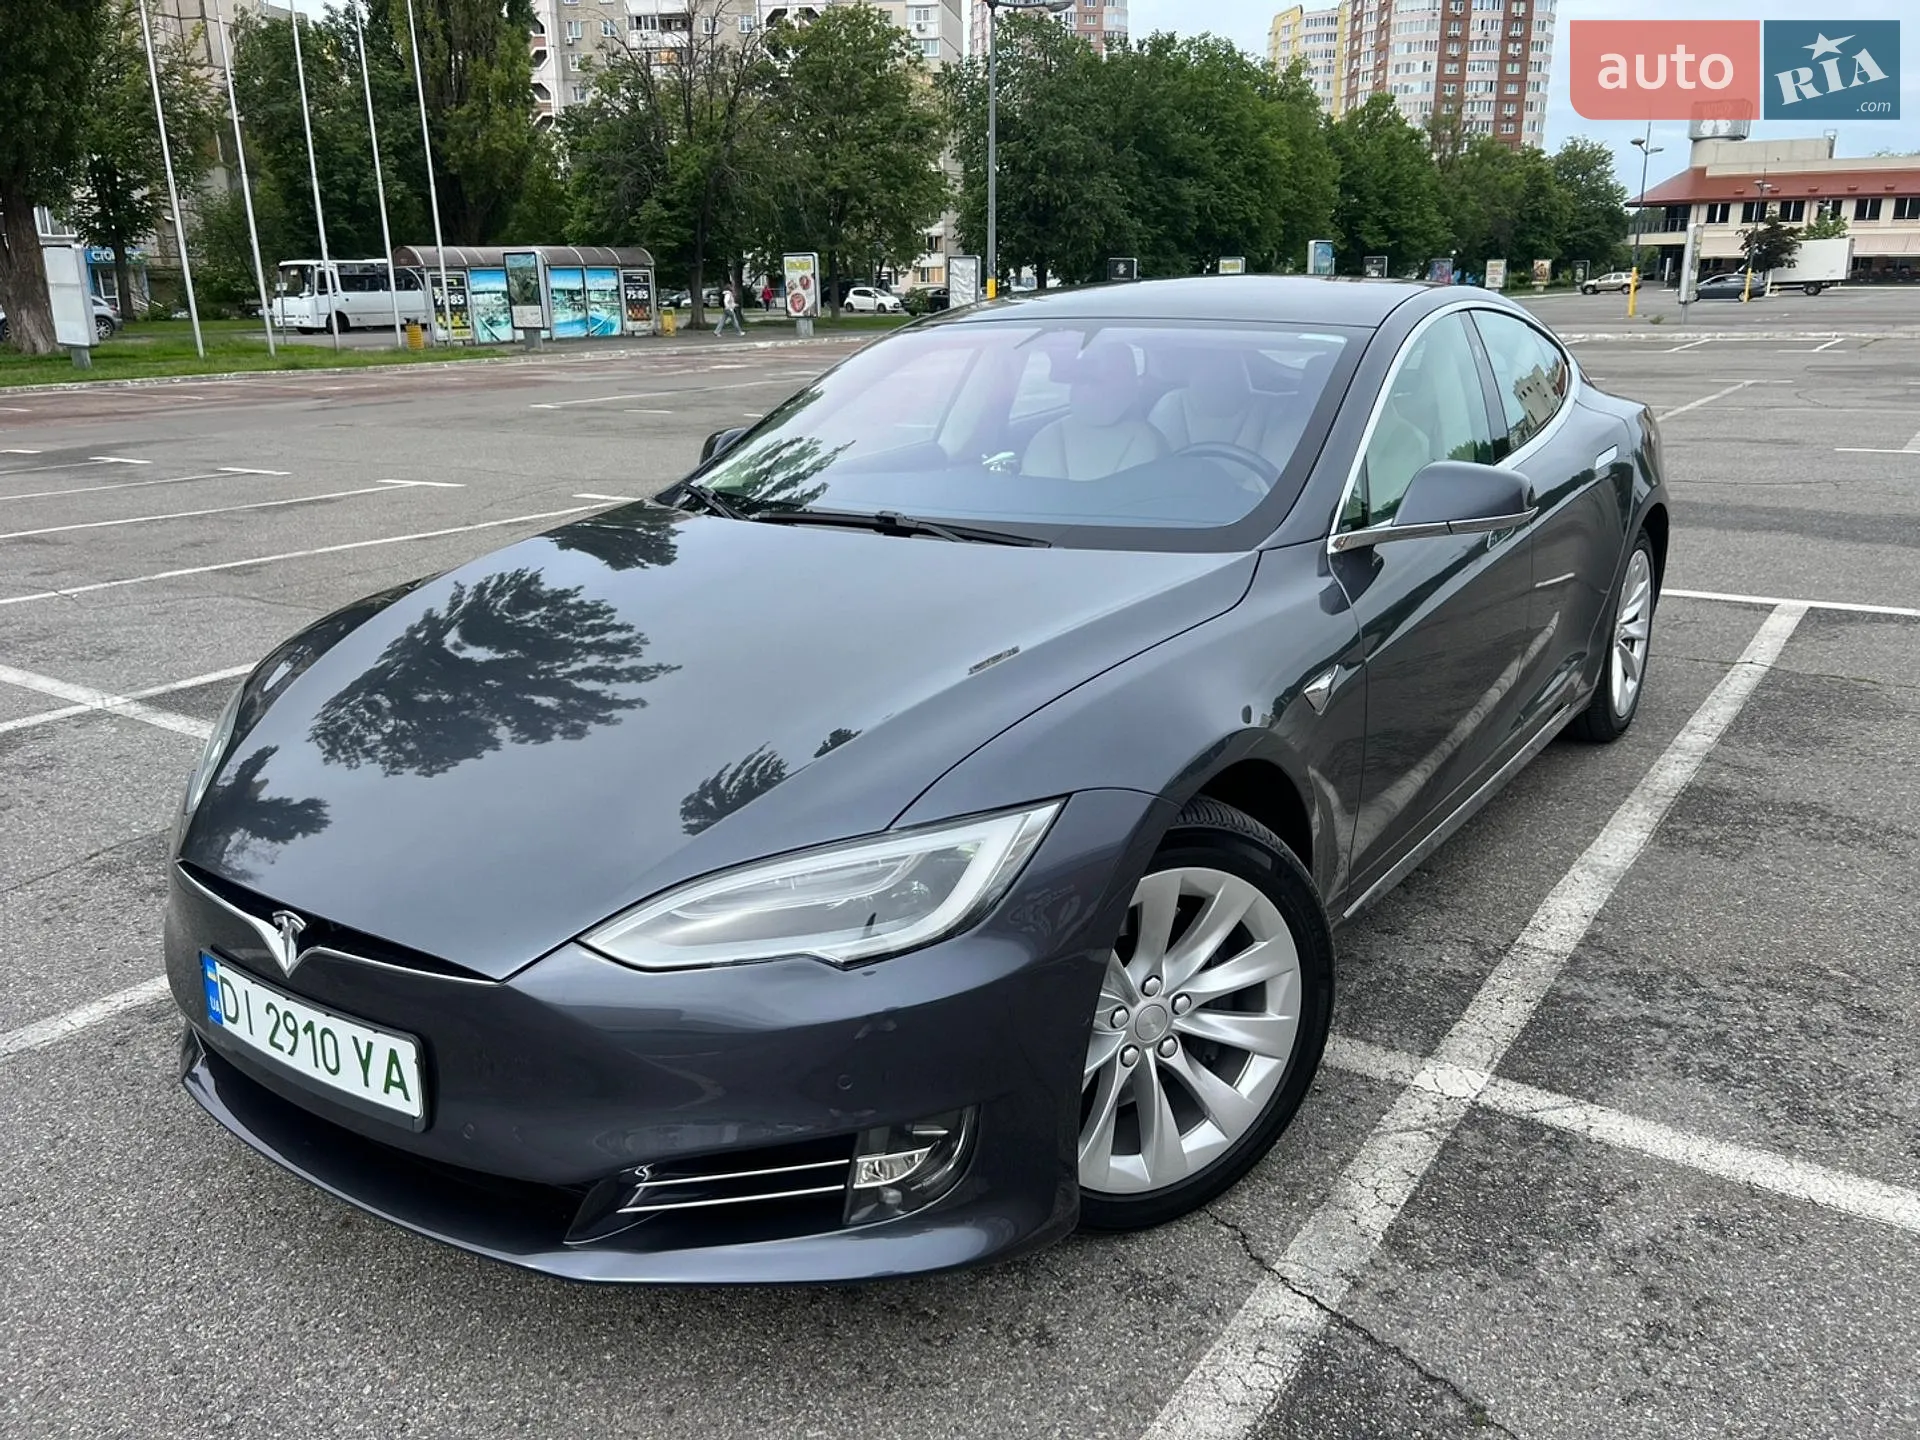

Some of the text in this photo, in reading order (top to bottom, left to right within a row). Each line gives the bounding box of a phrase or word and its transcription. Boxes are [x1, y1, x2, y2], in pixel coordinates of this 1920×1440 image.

[220, 974, 412, 1102] DI 2910 YA
